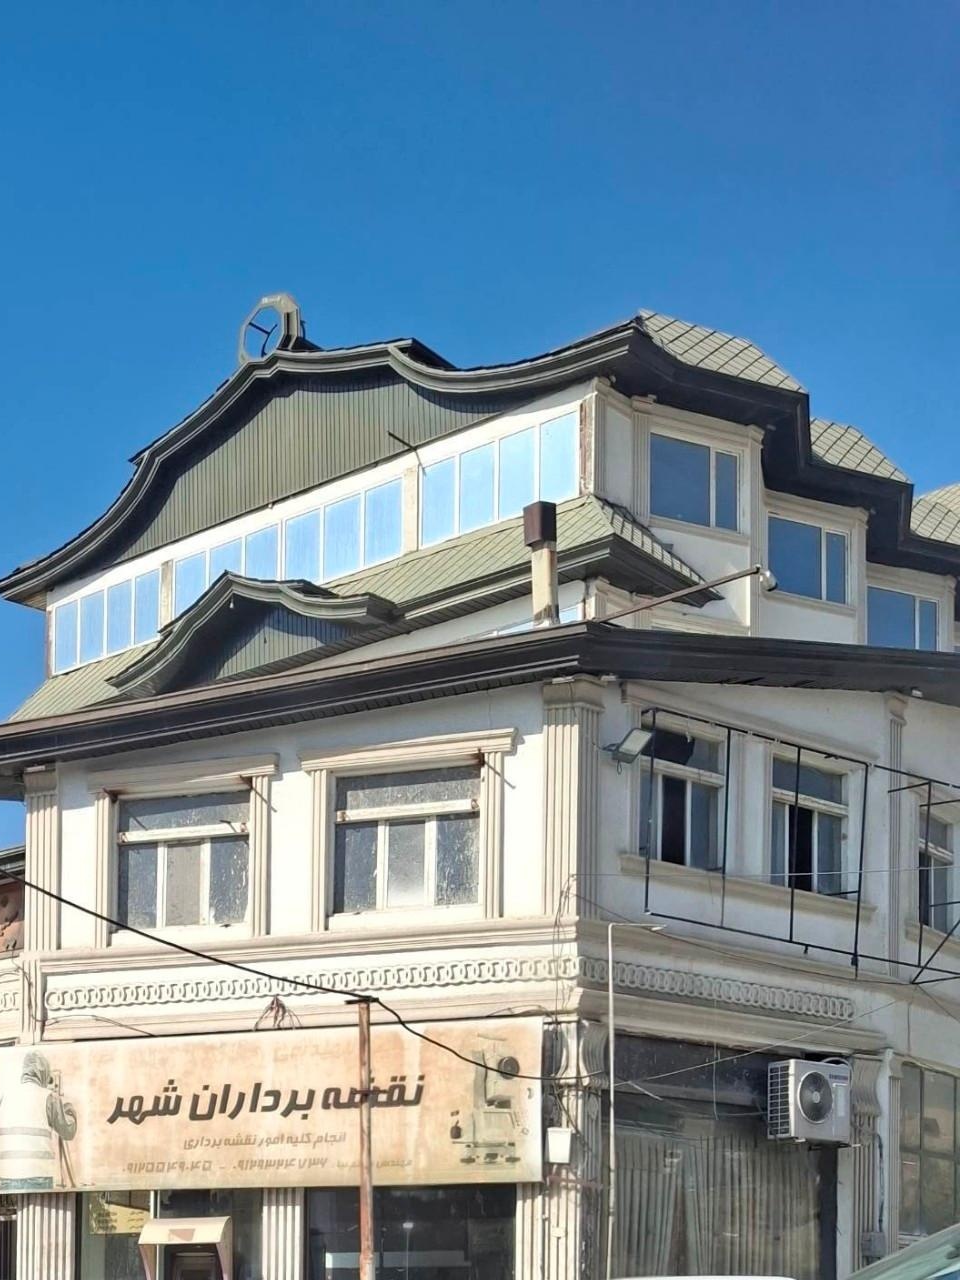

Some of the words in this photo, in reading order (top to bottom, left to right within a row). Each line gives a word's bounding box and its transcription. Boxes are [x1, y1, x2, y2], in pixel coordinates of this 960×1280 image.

[321, 1074, 425, 1110] نقشه
[107, 1079, 182, 1125] شهر
[190, 1082, 316, 1121] برداران
[183, 1136, 221, 1150] برداری
[224, 1133, 257, 1147] نقشه
[258, 1133, 285, 1148] امور
[286, 1132, 312, 1147] کلیه
[313, 1132, 347, 1148] انجام
